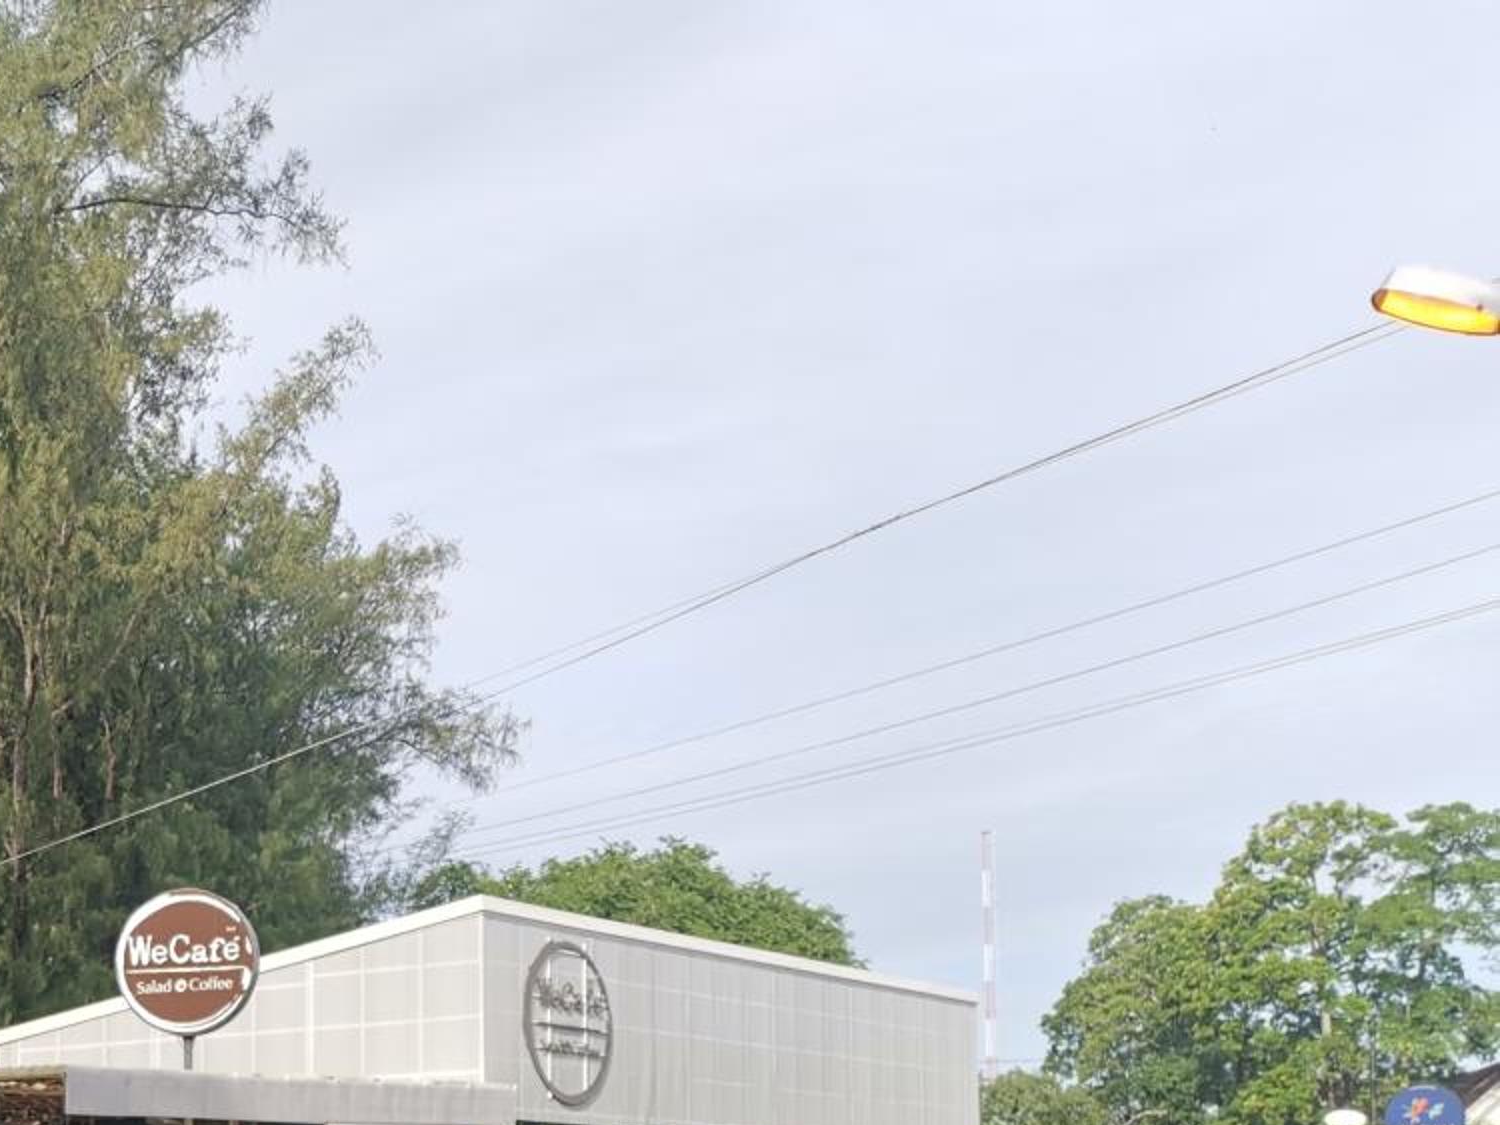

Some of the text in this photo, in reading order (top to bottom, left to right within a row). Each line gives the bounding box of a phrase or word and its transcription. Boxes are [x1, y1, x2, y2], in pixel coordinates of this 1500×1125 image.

[128, 933, 241, 967] WeCafé
[136, 976, 234, 995] Salad Coffee
